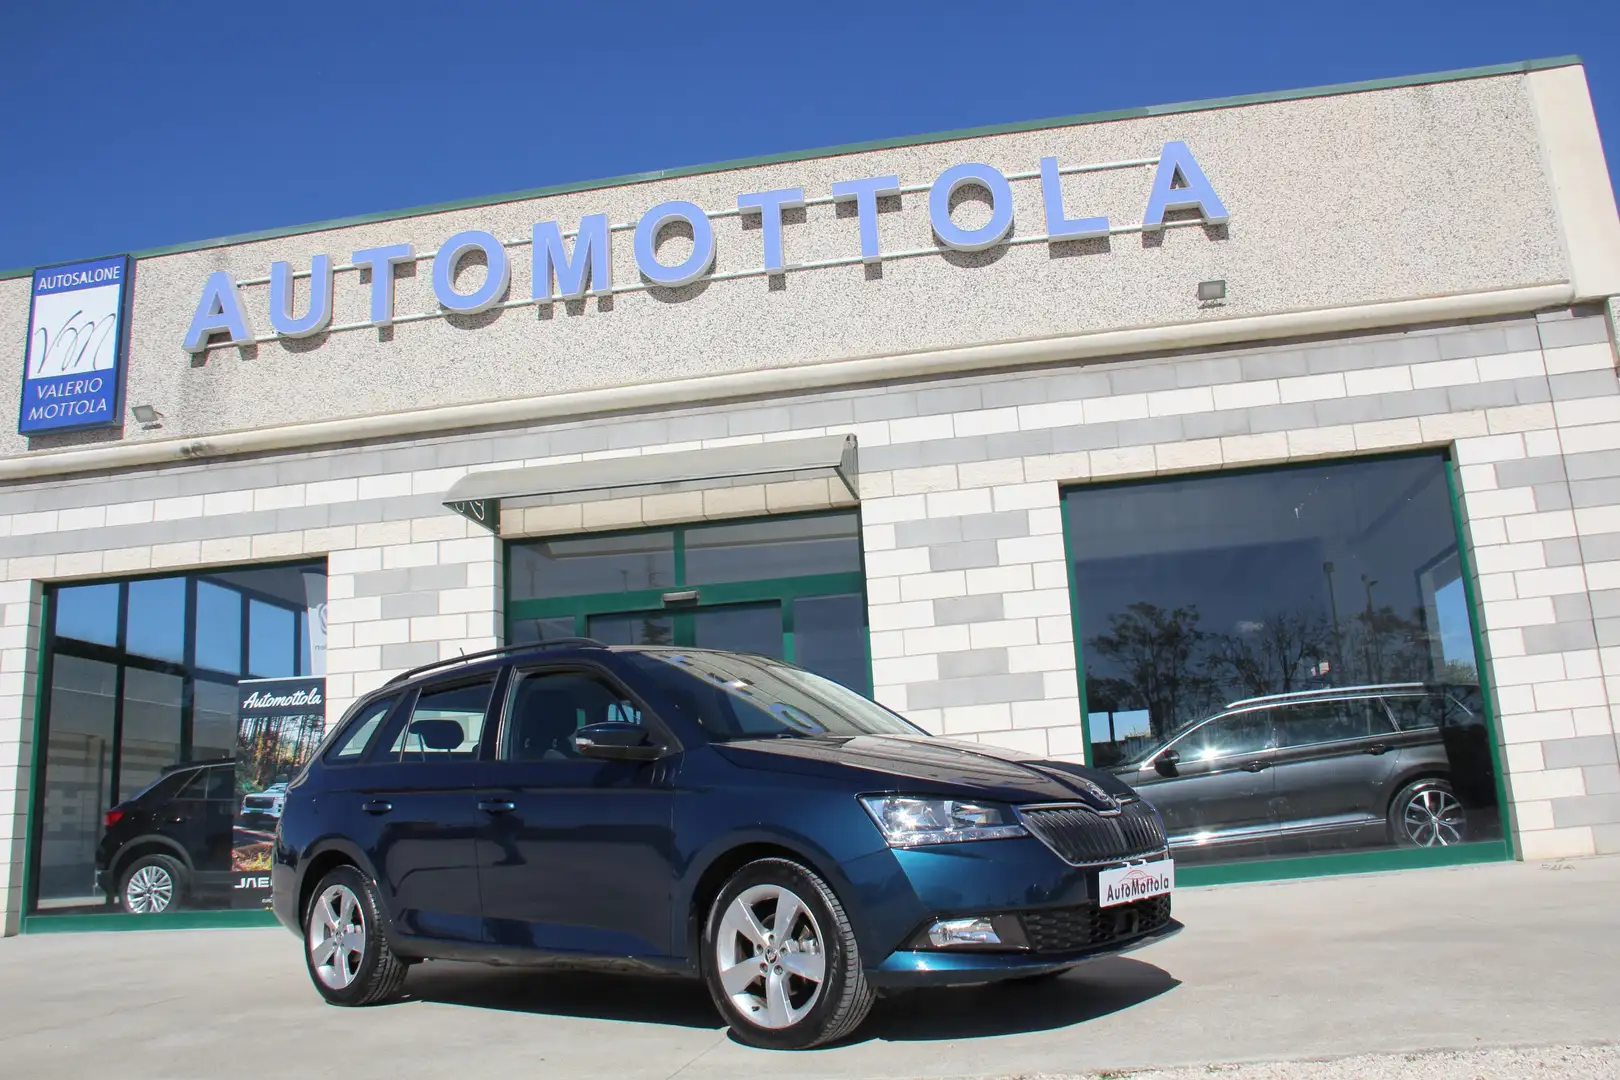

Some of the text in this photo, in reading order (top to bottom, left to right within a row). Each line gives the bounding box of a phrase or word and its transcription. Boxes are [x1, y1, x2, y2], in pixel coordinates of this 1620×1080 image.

[182, 140, 1230, 353] AUTOMOTTOLA
[38, 265, 121, 291] AUTOSALONE
[36, 377, 103, 399] VALERIO
[28, 398, 108, 421] MOTTOLA
[242, 687, 322, 709] Automottola
[233, 876, 273, 889] JAE
[1106, 873, 1169, 902] AutoMottola
